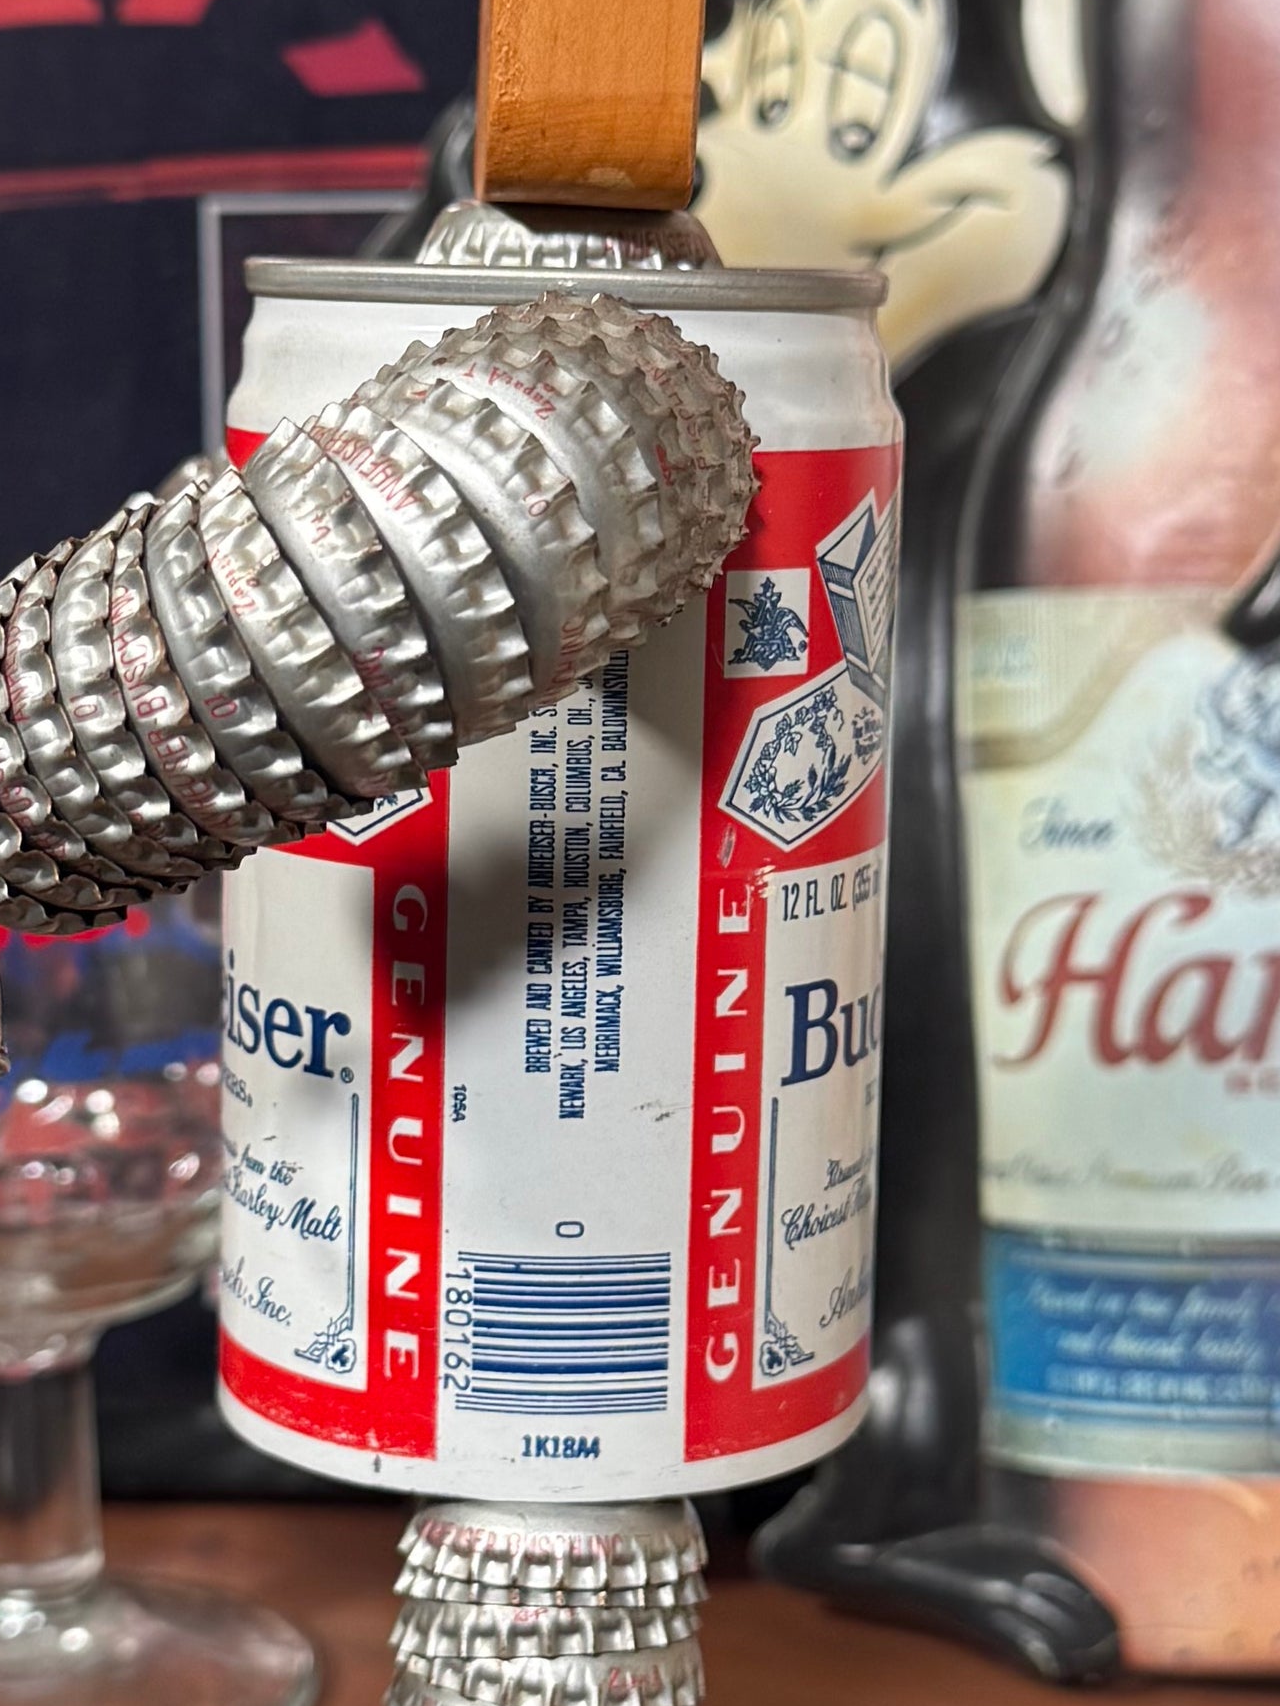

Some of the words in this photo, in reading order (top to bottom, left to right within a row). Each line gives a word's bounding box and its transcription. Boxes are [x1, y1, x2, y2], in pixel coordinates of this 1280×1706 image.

[530, 725, 557, 754] INC.
[565, 734, 595, 813] COLUMBUS,
[601, 759, 627, 782] CA.
[599, 790, 629, 860] FAIRFIELD,
[563, 822, 594, 888] HOUSTON,
[527, 895, 554, 913] BY
[562, 896, 592, 948] TAMPA,
[596, 868, 627, 978] WILLIAMSBURG,
[782, 882, 799, 922] 12
[805, 879, 825, 918] FL.
[527, 922, 554, 975] CANNED
[223, 948, 352, 1079] iser
[526, 982, 552, 1011] AND
[561, 957, 590, 1018] ANGELES,
[525, 1018, 552, 1073] BREWED
[560, 1026, 587, 1050] LOS
[594, 985, 624, 1073] MERRIMACK,
[559, 1059, 588, 1119] NEWARK,
[382, 883, 429, 1381] GENUINE
[705, 886, 751, 1382] GENUINE
[270, 1160, 295, 1186] the
[280, 1196, 342, 1242] Malt
[248, 1275, 292, 1327] Inc.
[444, 1266, 473, 1392] 180162
